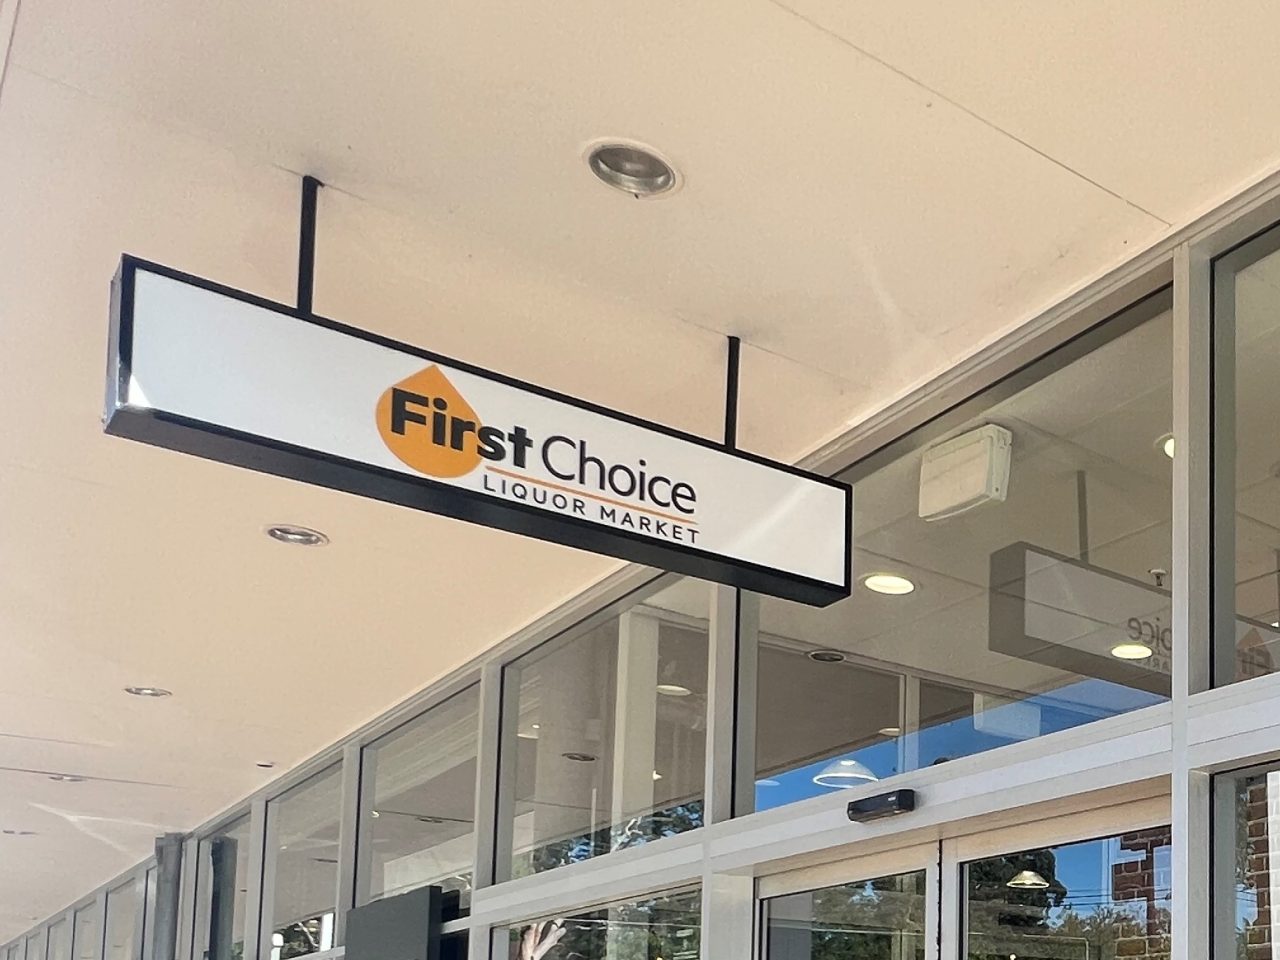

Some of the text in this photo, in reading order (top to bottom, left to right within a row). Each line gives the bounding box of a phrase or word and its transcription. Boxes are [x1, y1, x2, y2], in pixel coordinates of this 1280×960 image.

[391, 387, 697, 514] First Choice
[484, 474, 700, 544] LIQUOR MARKET
